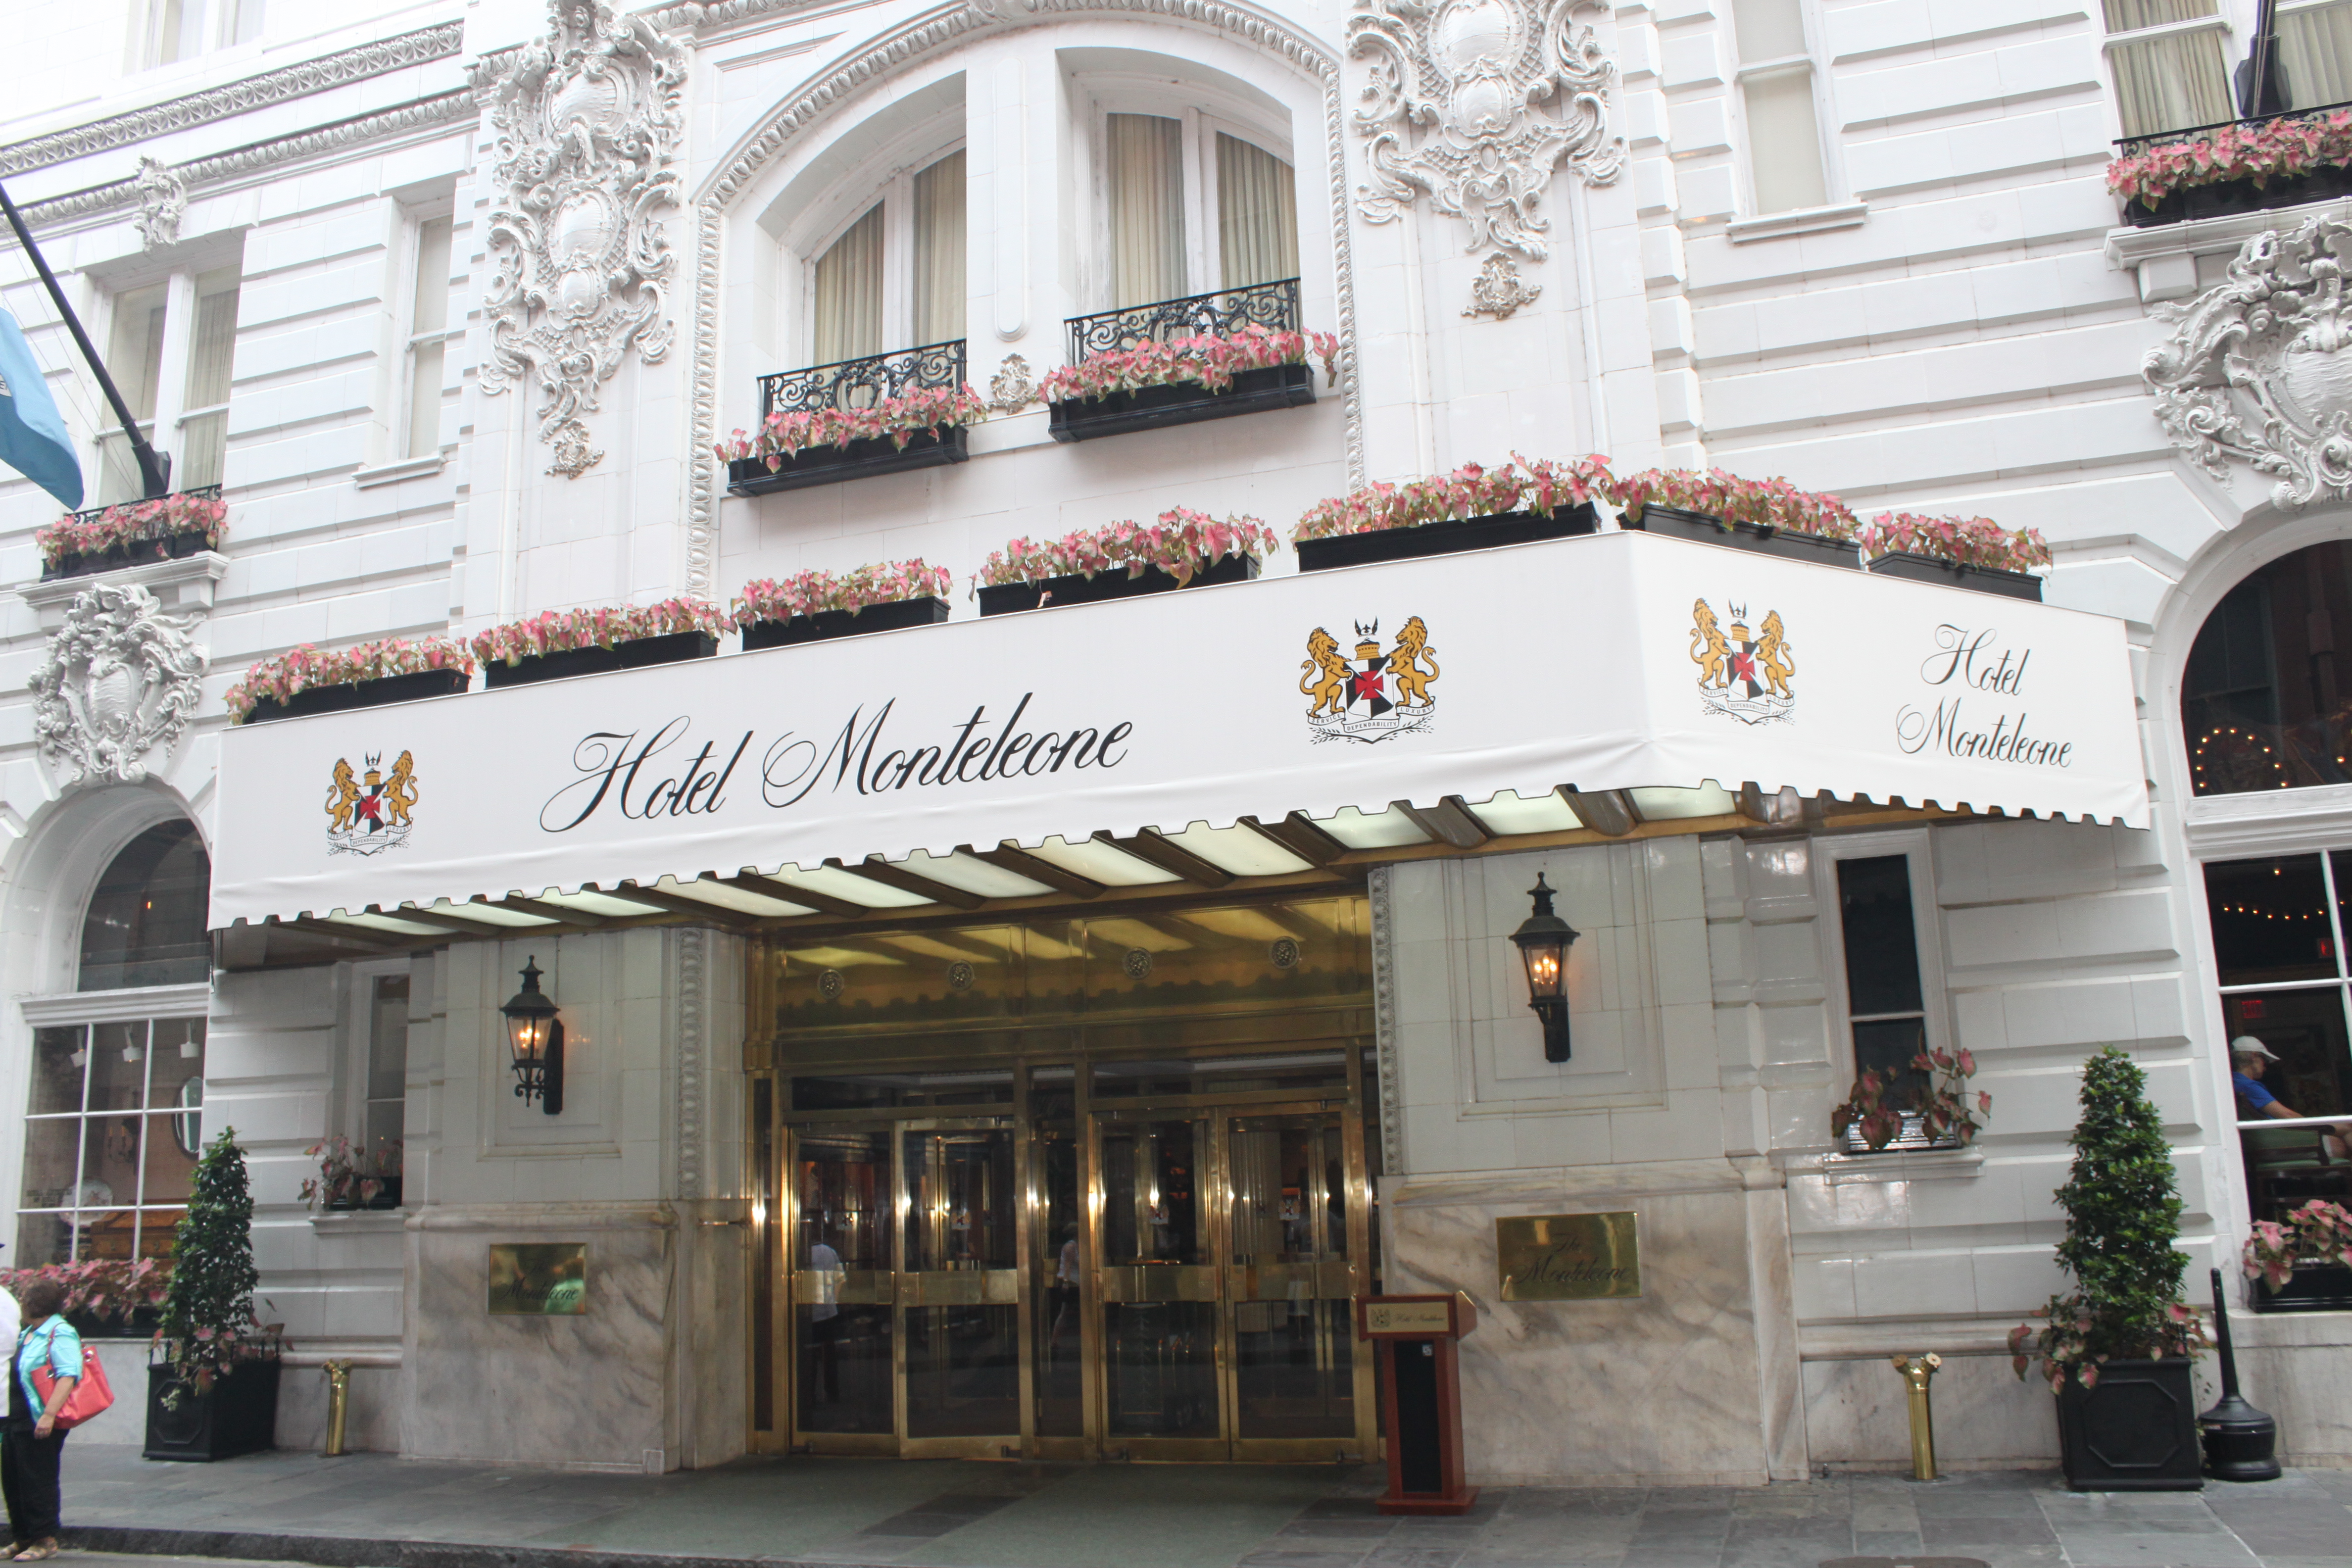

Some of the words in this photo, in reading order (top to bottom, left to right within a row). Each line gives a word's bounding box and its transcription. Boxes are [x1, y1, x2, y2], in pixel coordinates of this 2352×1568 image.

[1921, 624, 2030, 695] Hotel
[1312, 713, 1342, 724] SERVICE
[1400, 706, 1431, 715] LUXURY
[1347, 722, 1397, 731] DEPENDABILITY
[1896, 695, 2072, 768] Monteleone
[539, 715, 753, 833] Hotel
[763, 691, 1133, 808] Monteleone
[1511, 1254, 1630, 1284] Monteleone
